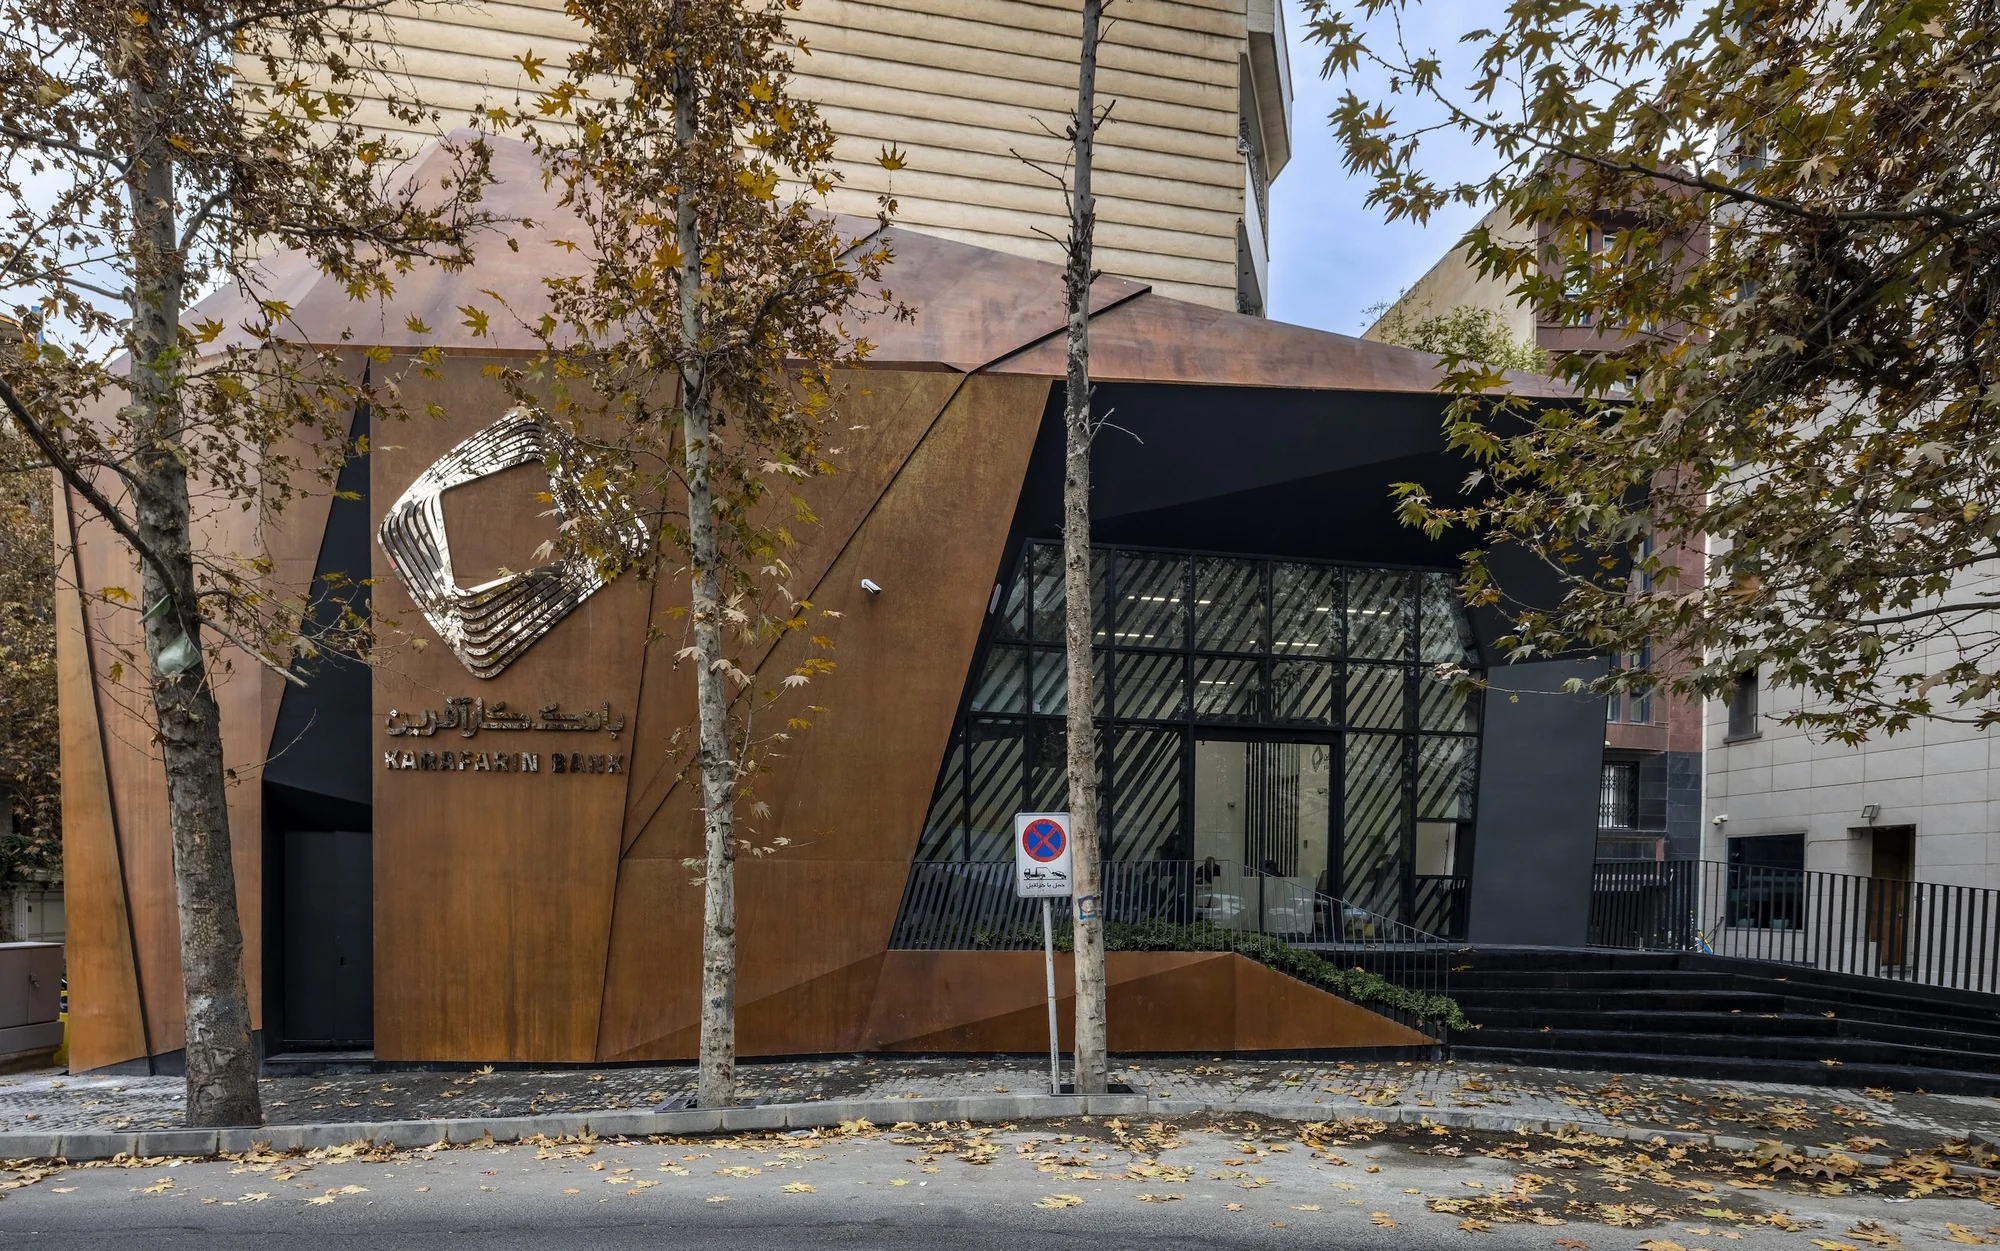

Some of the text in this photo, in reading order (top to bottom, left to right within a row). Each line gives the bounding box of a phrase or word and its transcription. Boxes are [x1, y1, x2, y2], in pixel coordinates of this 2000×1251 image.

[383, 696, 625, 741] بانک کارآفرین
[384, 748, 624, 774] KARAFARIN BANK
